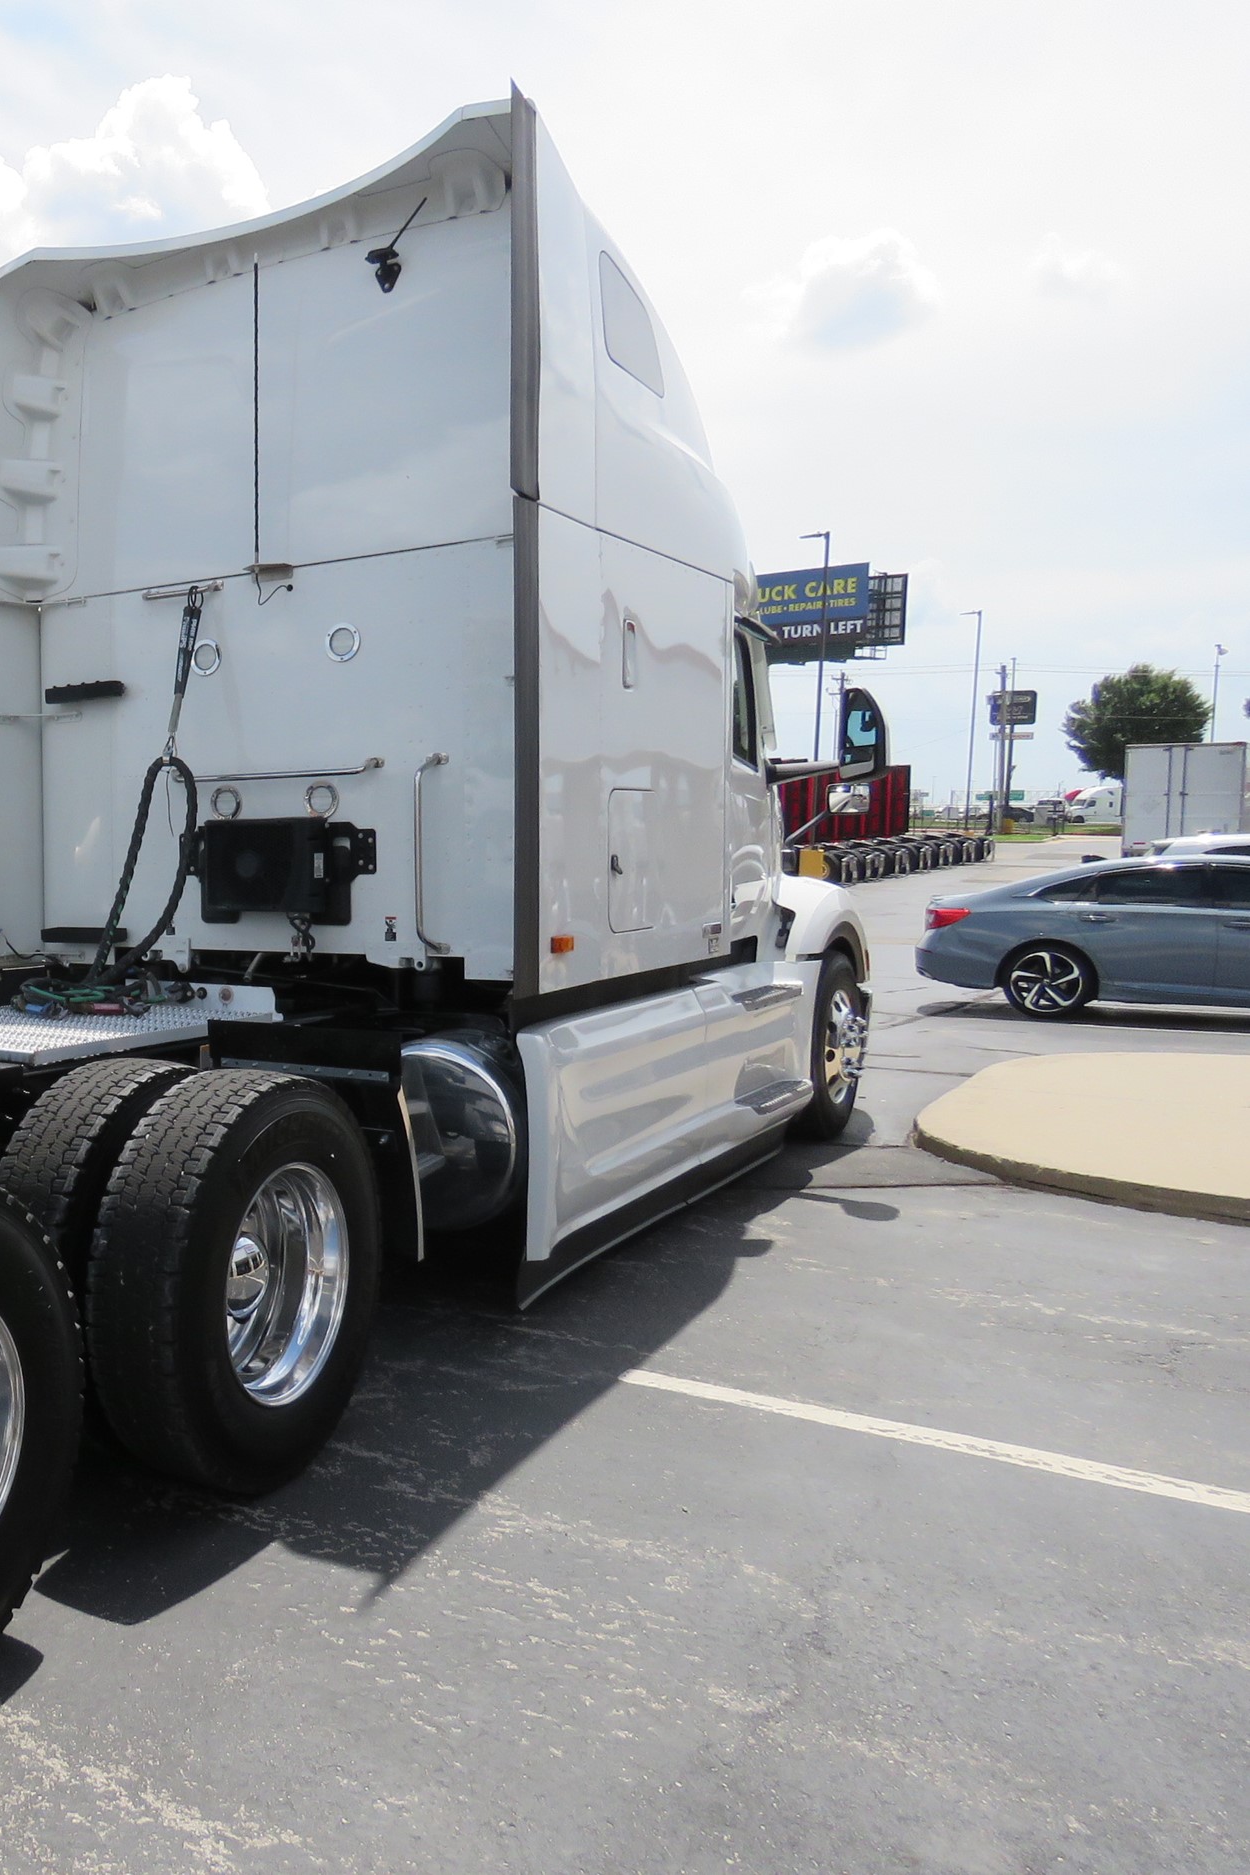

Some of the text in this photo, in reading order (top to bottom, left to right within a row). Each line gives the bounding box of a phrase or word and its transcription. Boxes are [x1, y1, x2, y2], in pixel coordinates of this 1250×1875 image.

[757, 577, 857, 603] UCK CARE
[760, 598, 856, 615] LUBE REPAIR TIRES
[782, 619, 864, 639] TURN LEFT
